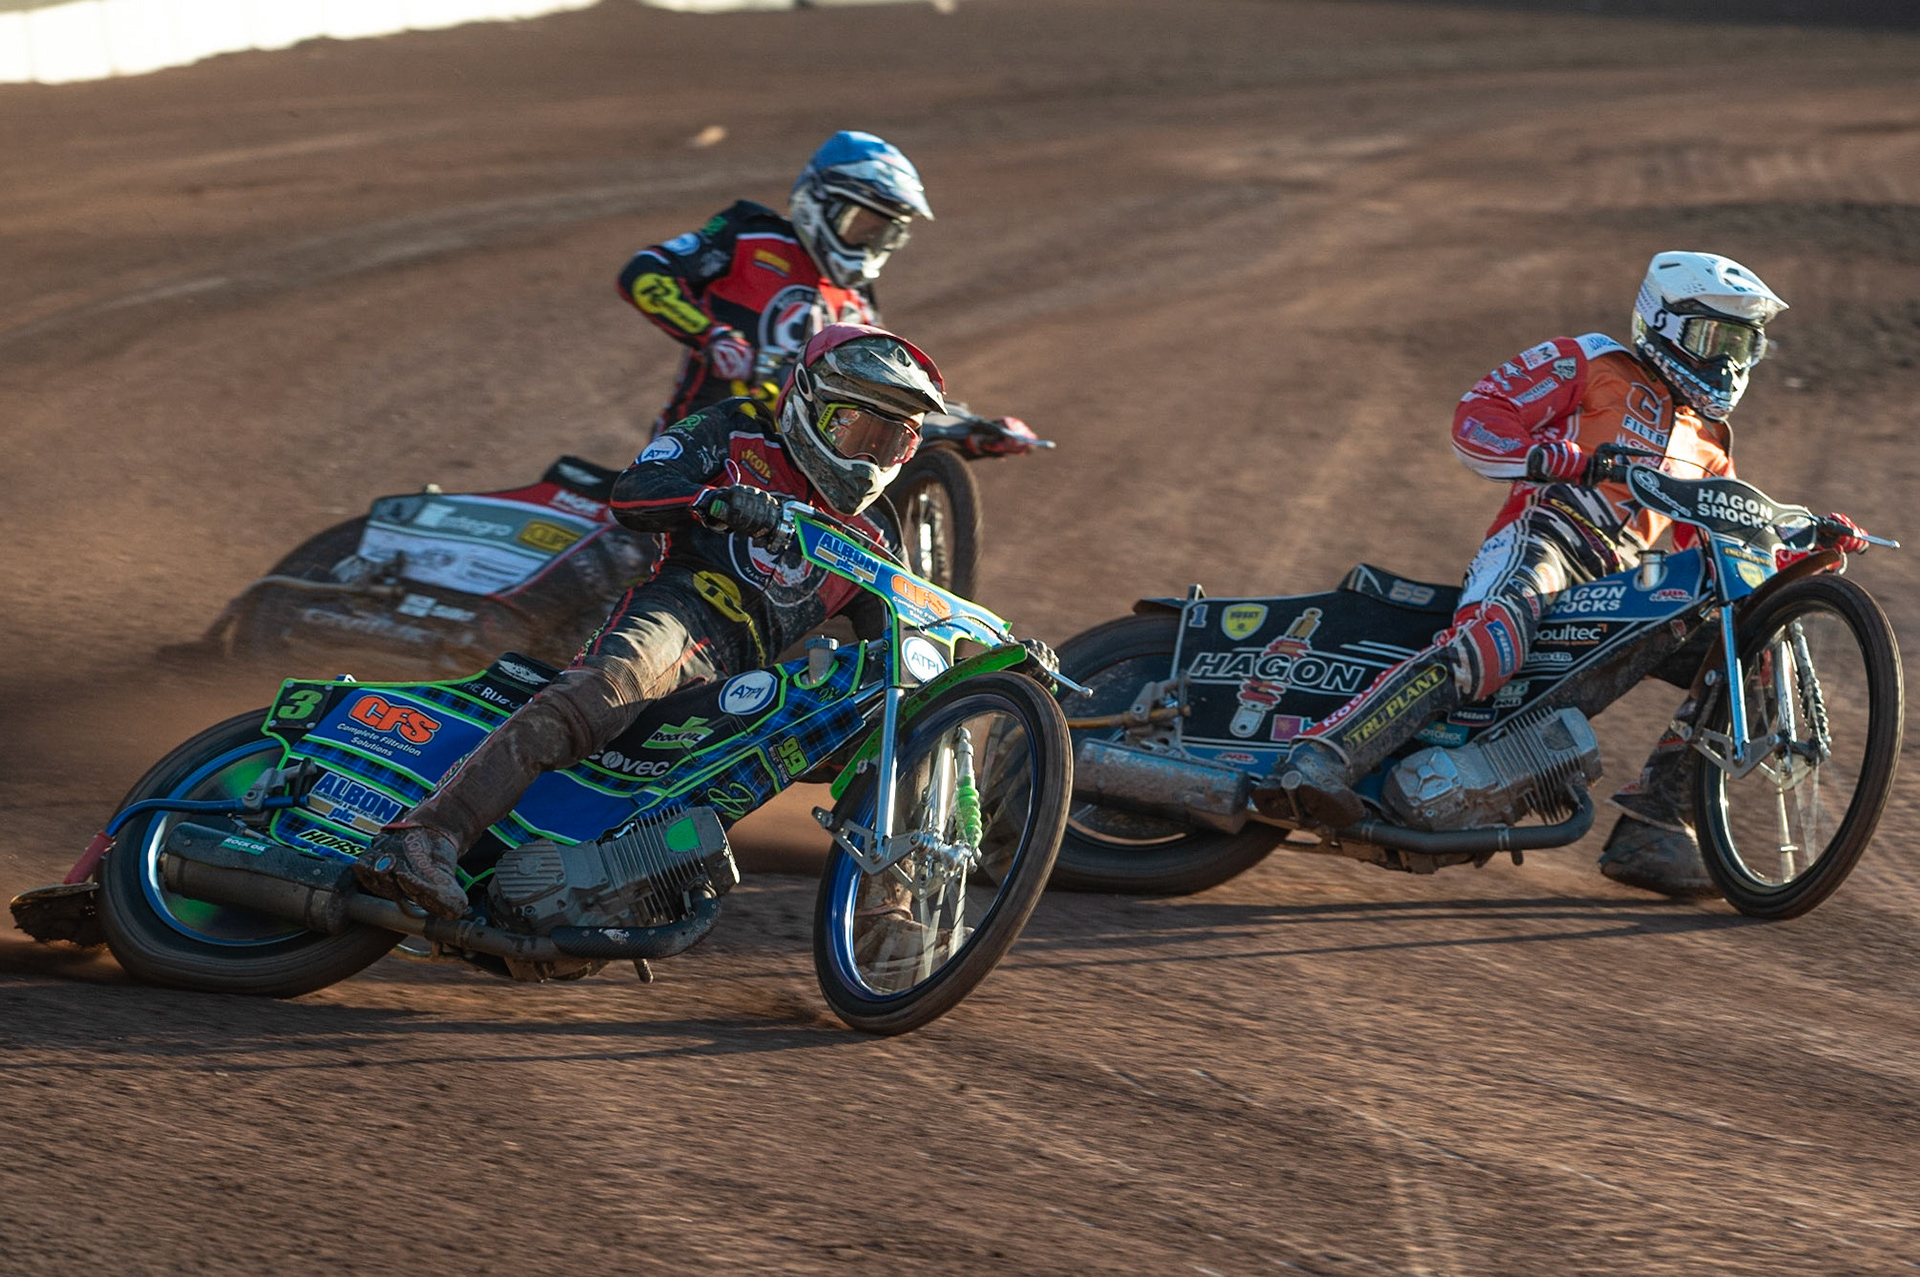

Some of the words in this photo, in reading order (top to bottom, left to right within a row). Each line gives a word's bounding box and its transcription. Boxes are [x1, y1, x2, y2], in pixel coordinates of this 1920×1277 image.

[1698, 488, 1773, 520] HAGON
[819, 532, 879, 574] ALBON
[892, 574, 951, 620] CFS
[1553, 599, 1622, 614] OCKS
[1555, 586, 1627, 603] AGON
[1188, 604, 1208, 628] 1
[1188, 653, 1365, 692] HAGON
[277, 689, 324, 719] 3
[729, 684, 765, 700] ATPI
[1387, 669, 1440, 717] PLANT
[350, 695, 441, 744] CFS
[336, 723, 380, 742] Complete
[380, 735, 422, 757] Filtration
[350, 736, 393, 757] Solutions
[314, 772, 402, 822] ALBON
[327, 806, 356, 824] plc
[223, 837, 250, 849] ROCK
[249, 842, 267, 852] OIL
